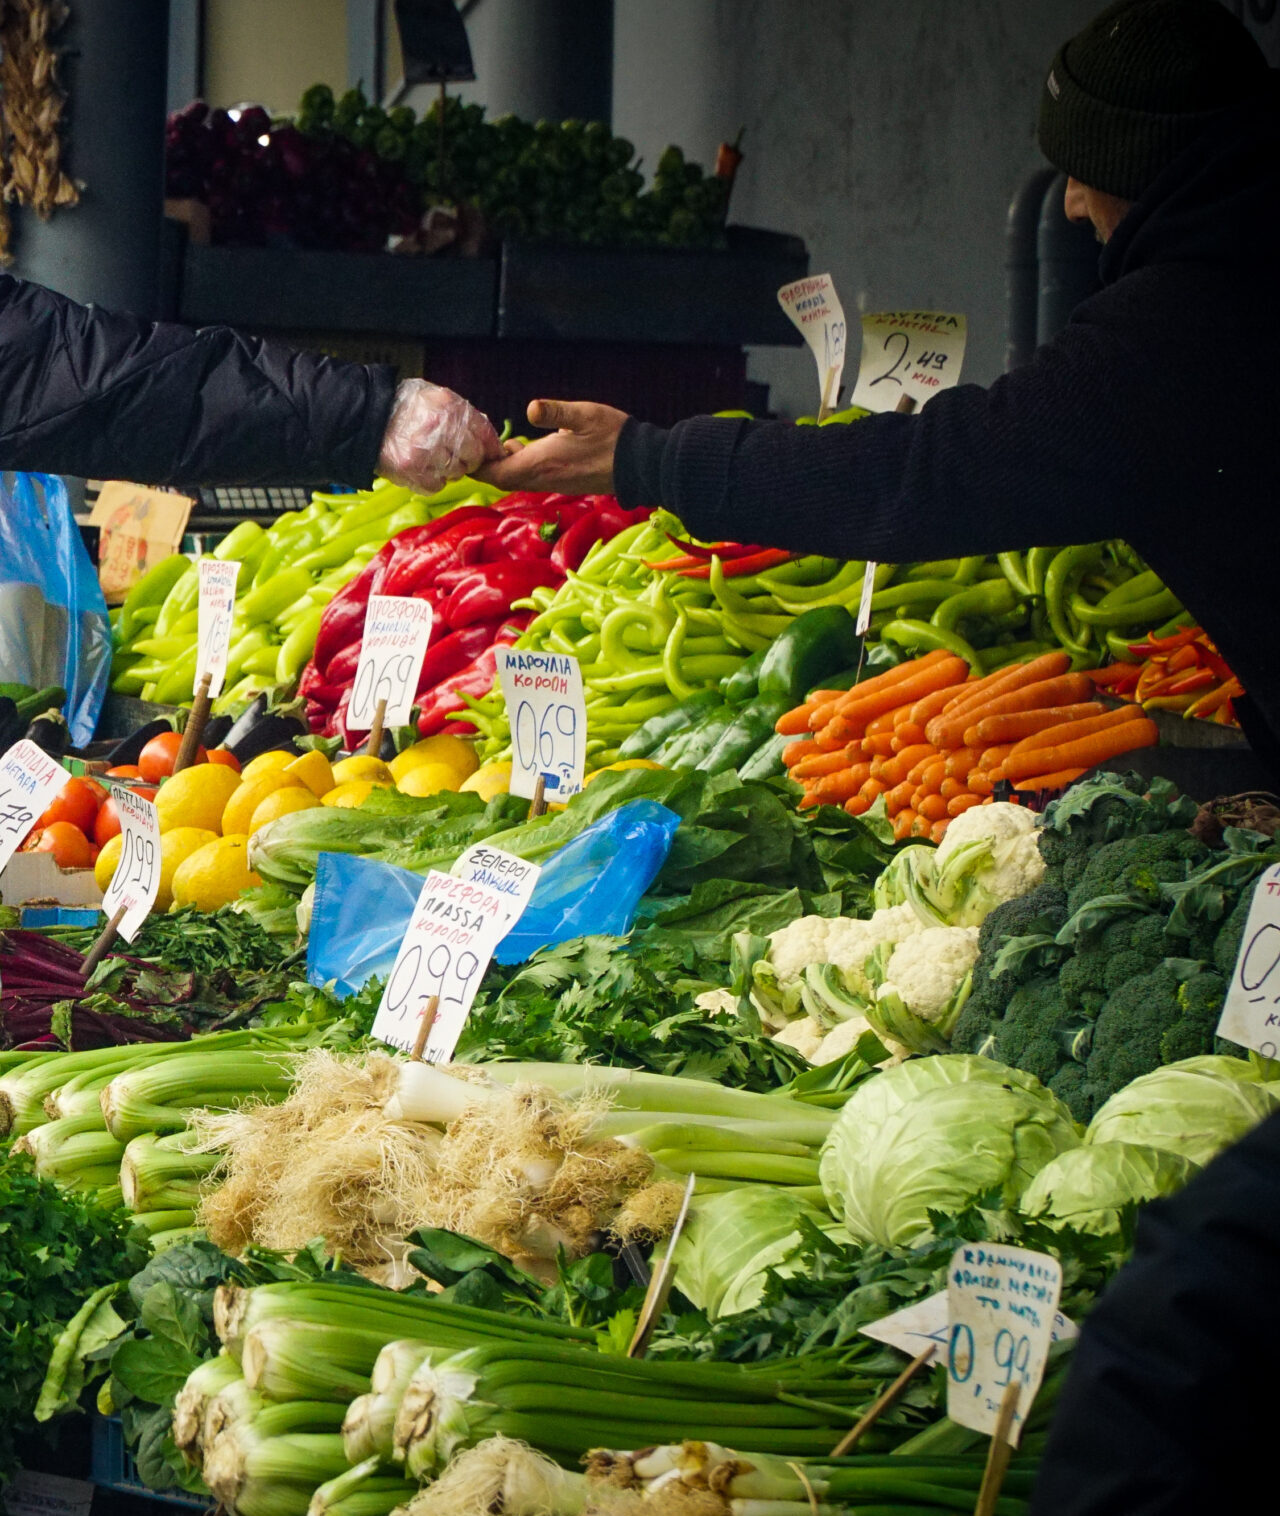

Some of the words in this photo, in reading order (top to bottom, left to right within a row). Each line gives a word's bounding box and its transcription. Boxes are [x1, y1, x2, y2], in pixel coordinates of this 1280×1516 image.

[870, 332, 948, 387] 2,49
[368, 600, 428, 623] ΠΡΟΣΦΟΡΑ
[353, 655, 415, 720] 0,69
[506, 655, 572, 676] ΜΑΡΟΥΛΙΑ
[517, 701, 577, 776] 0,69
[424, 875, 499, 917] ΠΡΟΣΦΟΡΑ
[387, 945, 479, 1021] 0,99
